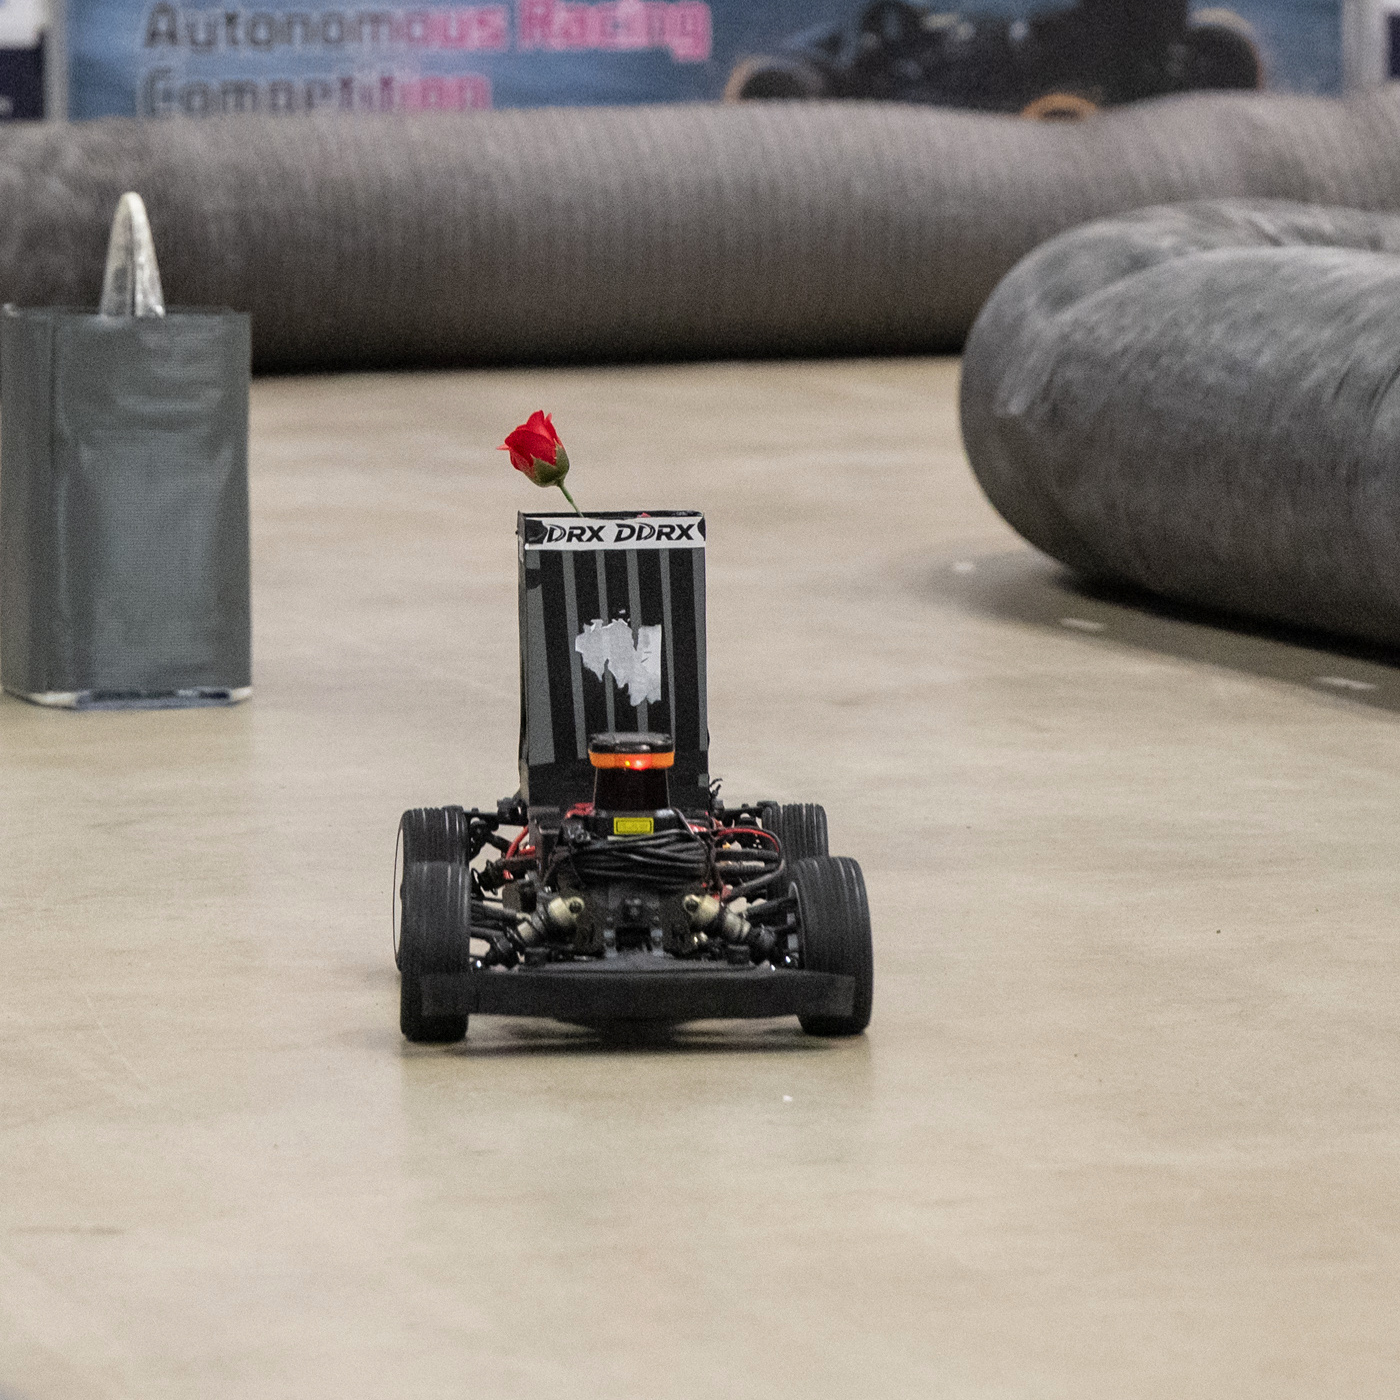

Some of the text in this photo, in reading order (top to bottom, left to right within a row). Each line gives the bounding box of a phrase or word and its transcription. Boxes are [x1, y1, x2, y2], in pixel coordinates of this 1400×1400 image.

[145, 0, 506, 50] Autonomous
[545, 521, 696, 543] DRX DDRX
